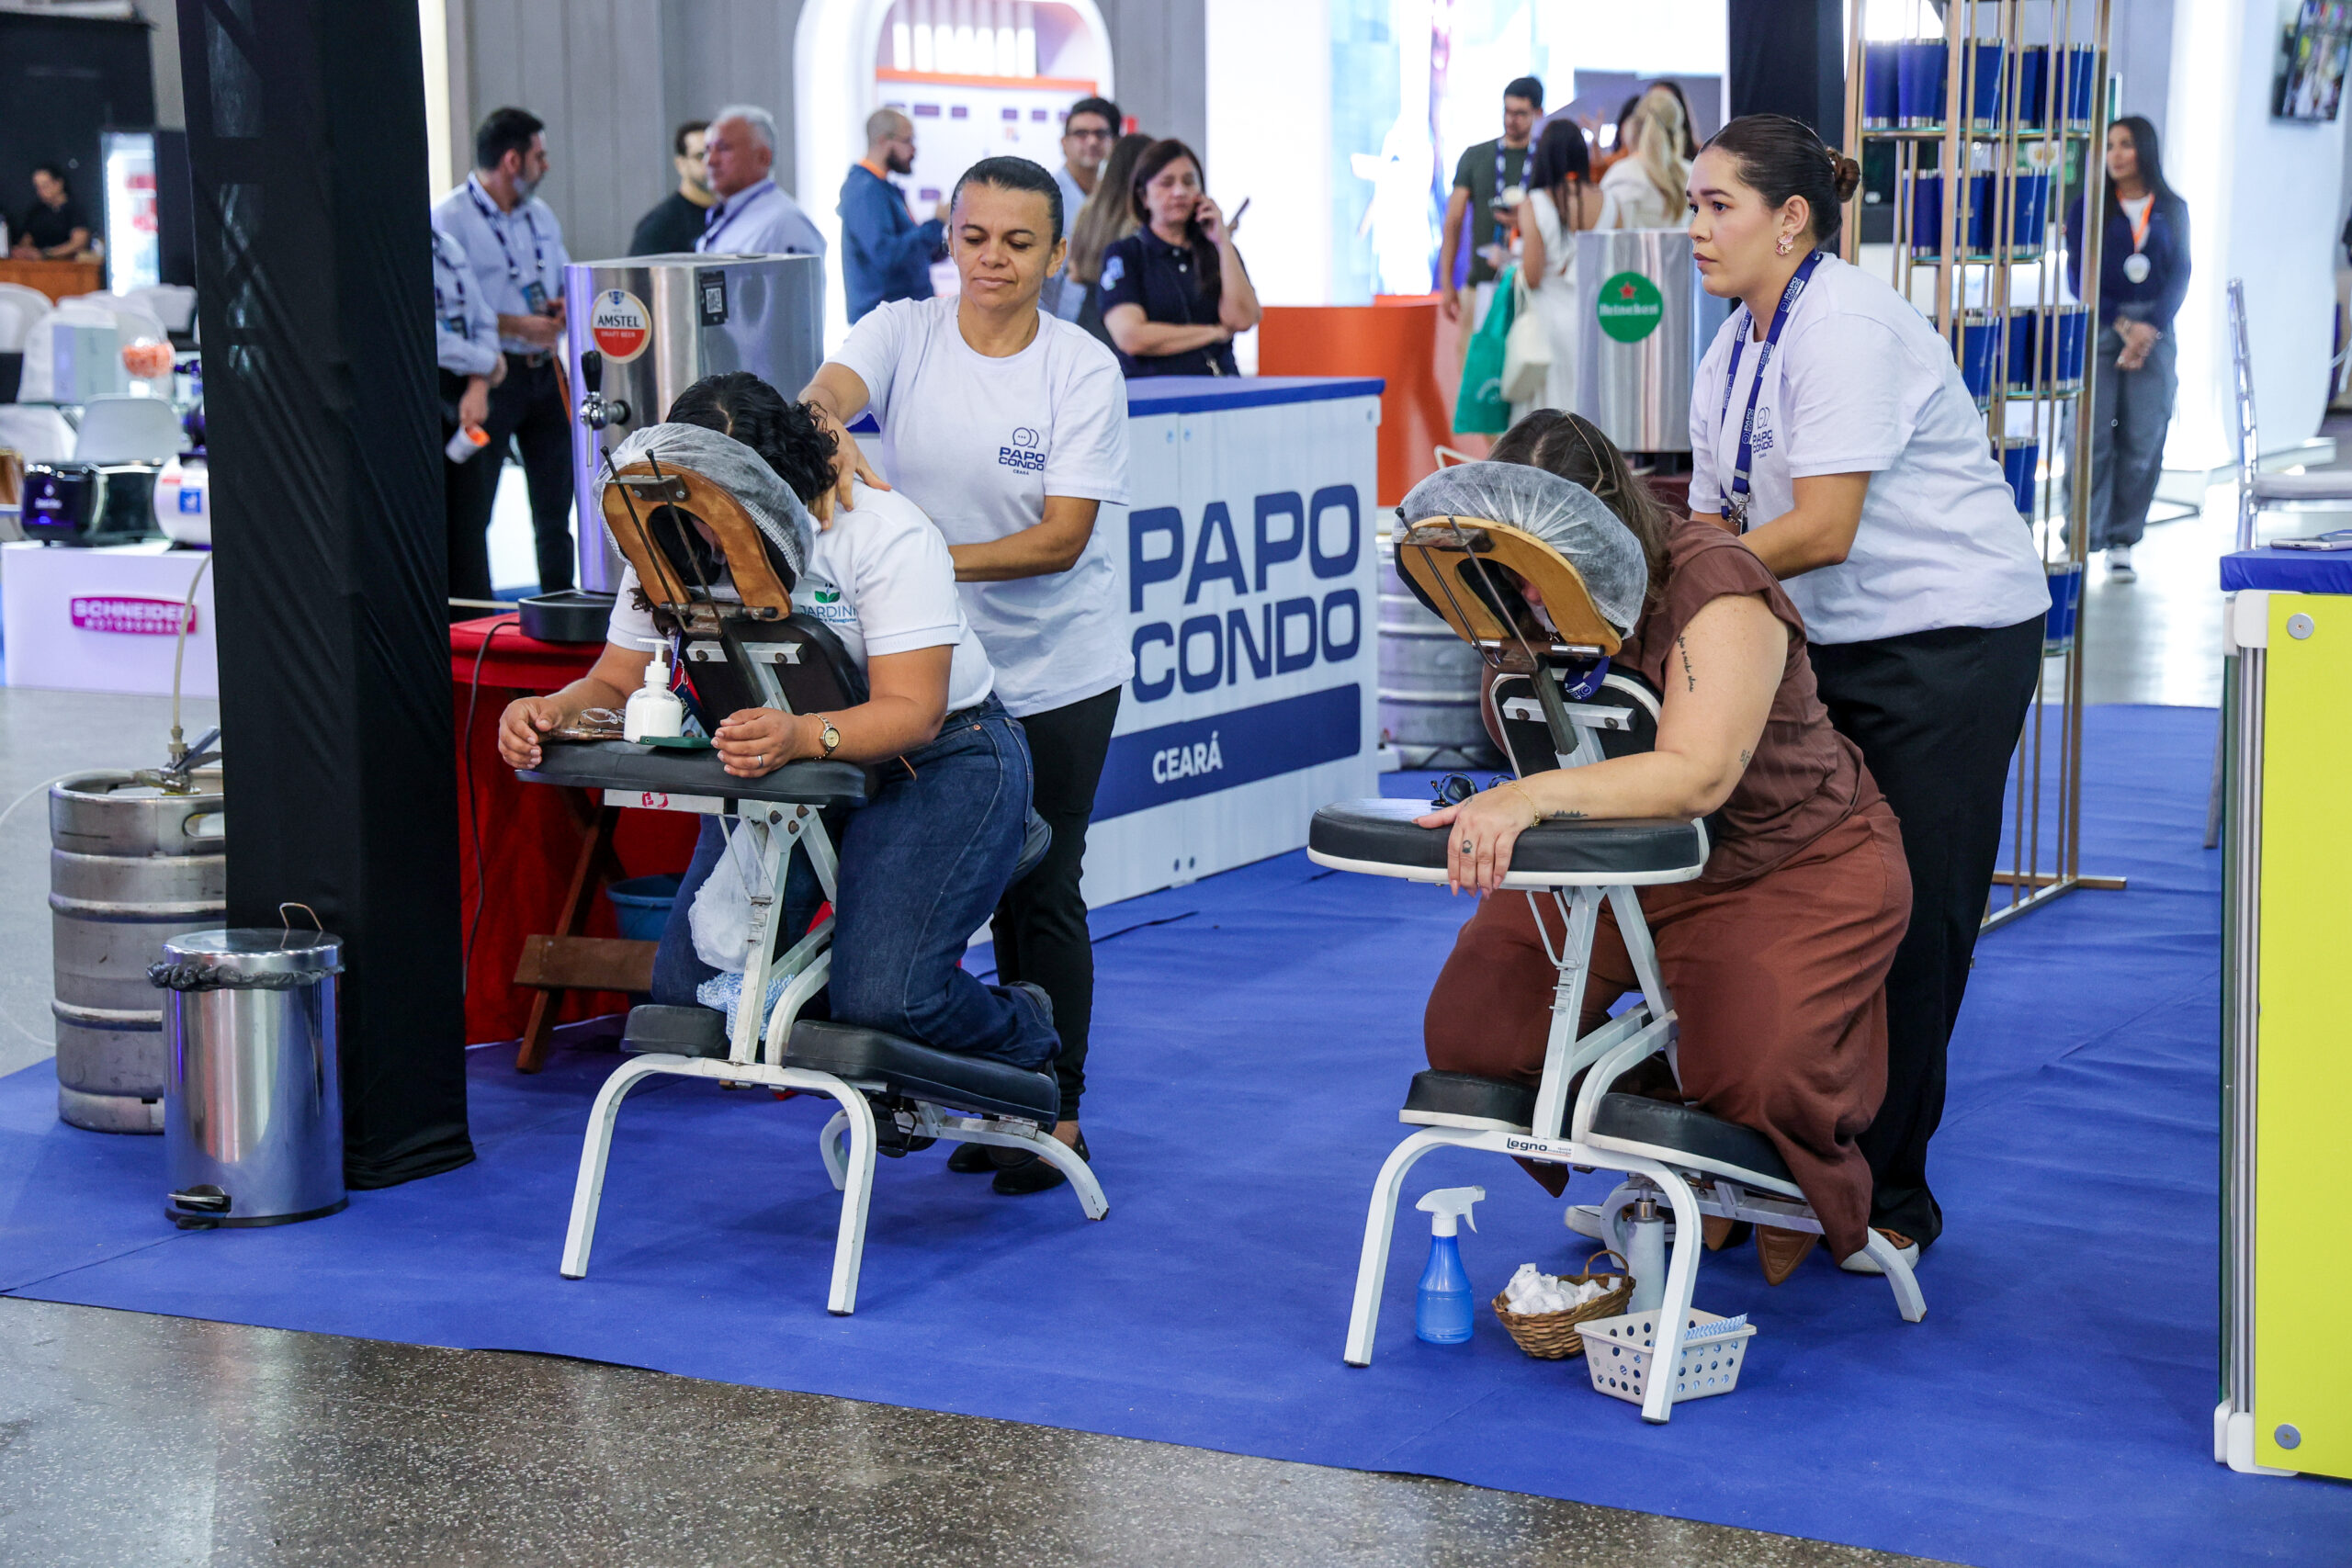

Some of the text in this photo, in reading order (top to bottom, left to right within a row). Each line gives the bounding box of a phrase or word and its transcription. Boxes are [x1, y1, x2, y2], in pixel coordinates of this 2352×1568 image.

[1599, 302, 1659, 317] Heineken
[597, 314, 640, 327] AMSTEL
[1752, 430, 1772, 445] PAPO
[1753, 440, 1773, 454] CONDO
[1000, 447, 1045, 463] PAPO
[999, 457, 1045, 471] CONDO
[1129, 484, 1360, 614] PAPO
[1133, 589, 1360, 703] CONDO
[1152, 730, 1223, 784] CEARÁ
